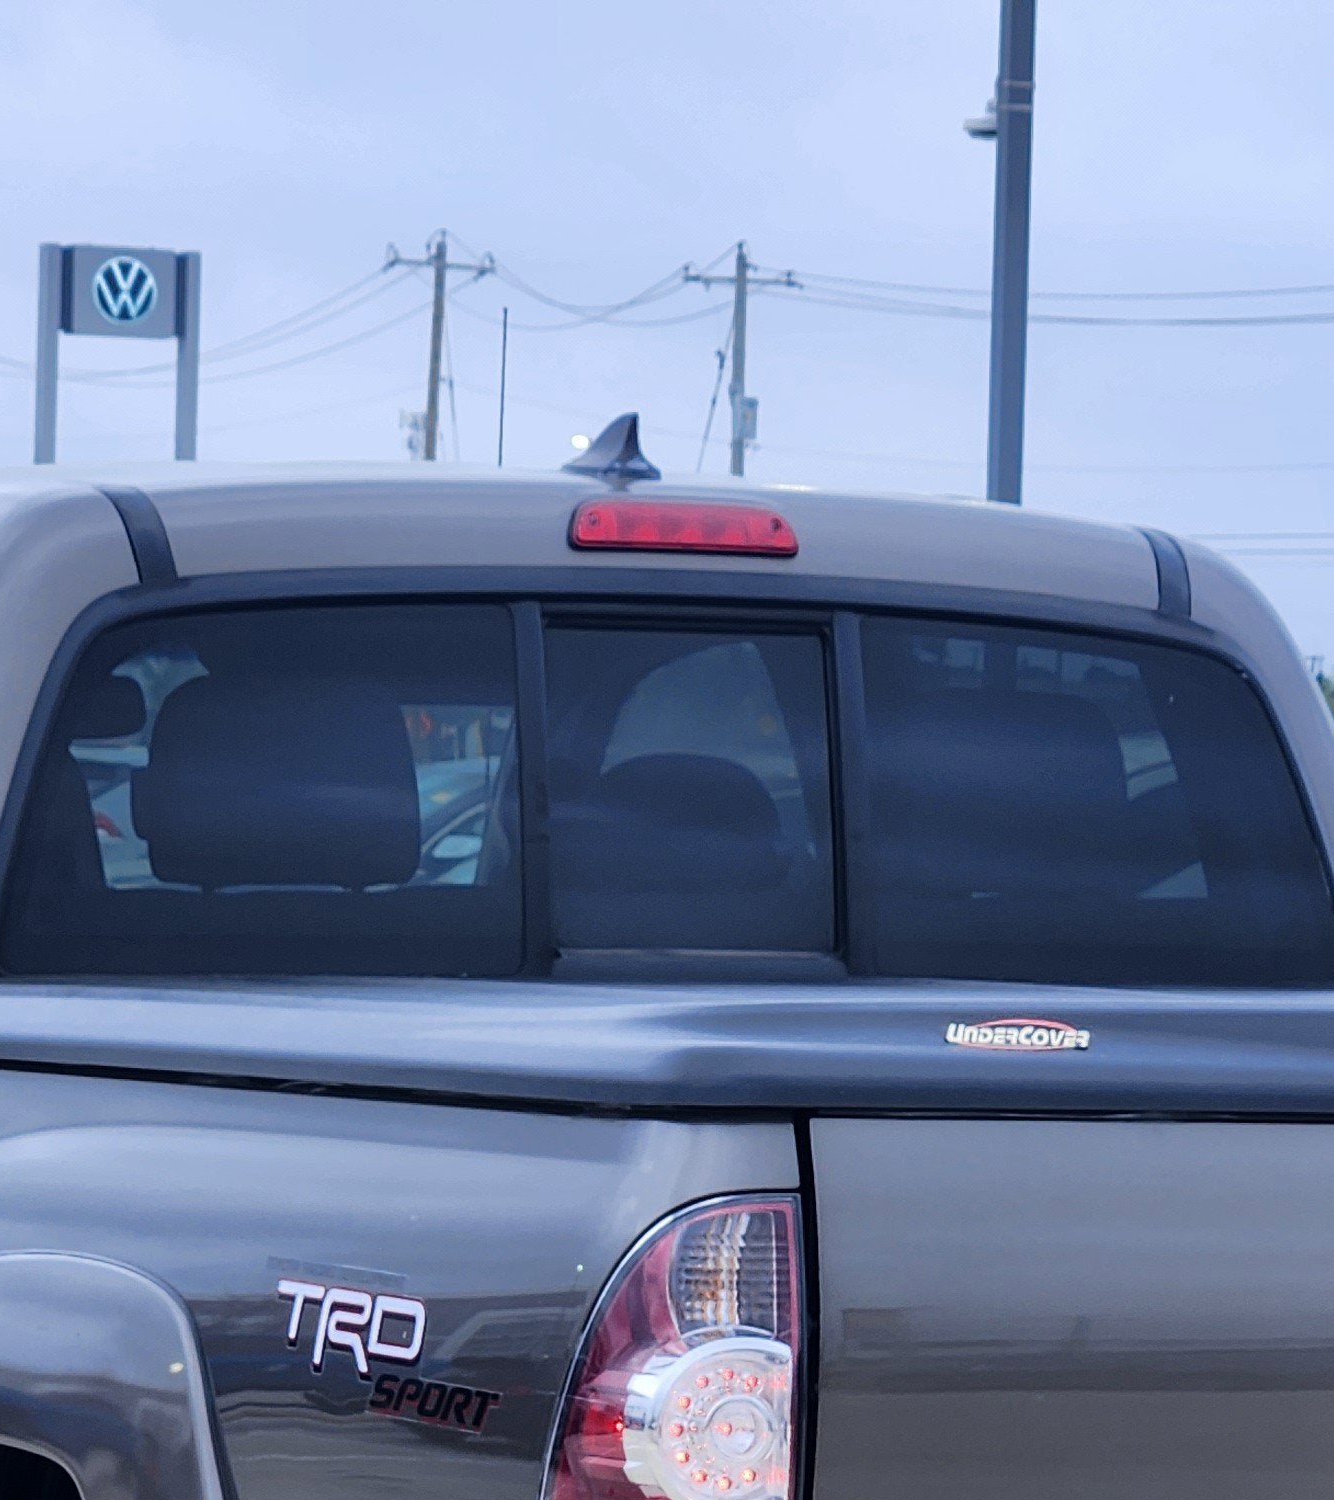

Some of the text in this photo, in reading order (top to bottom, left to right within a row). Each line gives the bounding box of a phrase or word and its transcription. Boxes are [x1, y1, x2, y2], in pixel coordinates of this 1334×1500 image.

[93, 256, 157, 323] VW
[277, 1278, 426, 1379] TRD
[369, 1373, 502, 1431] SPORT
